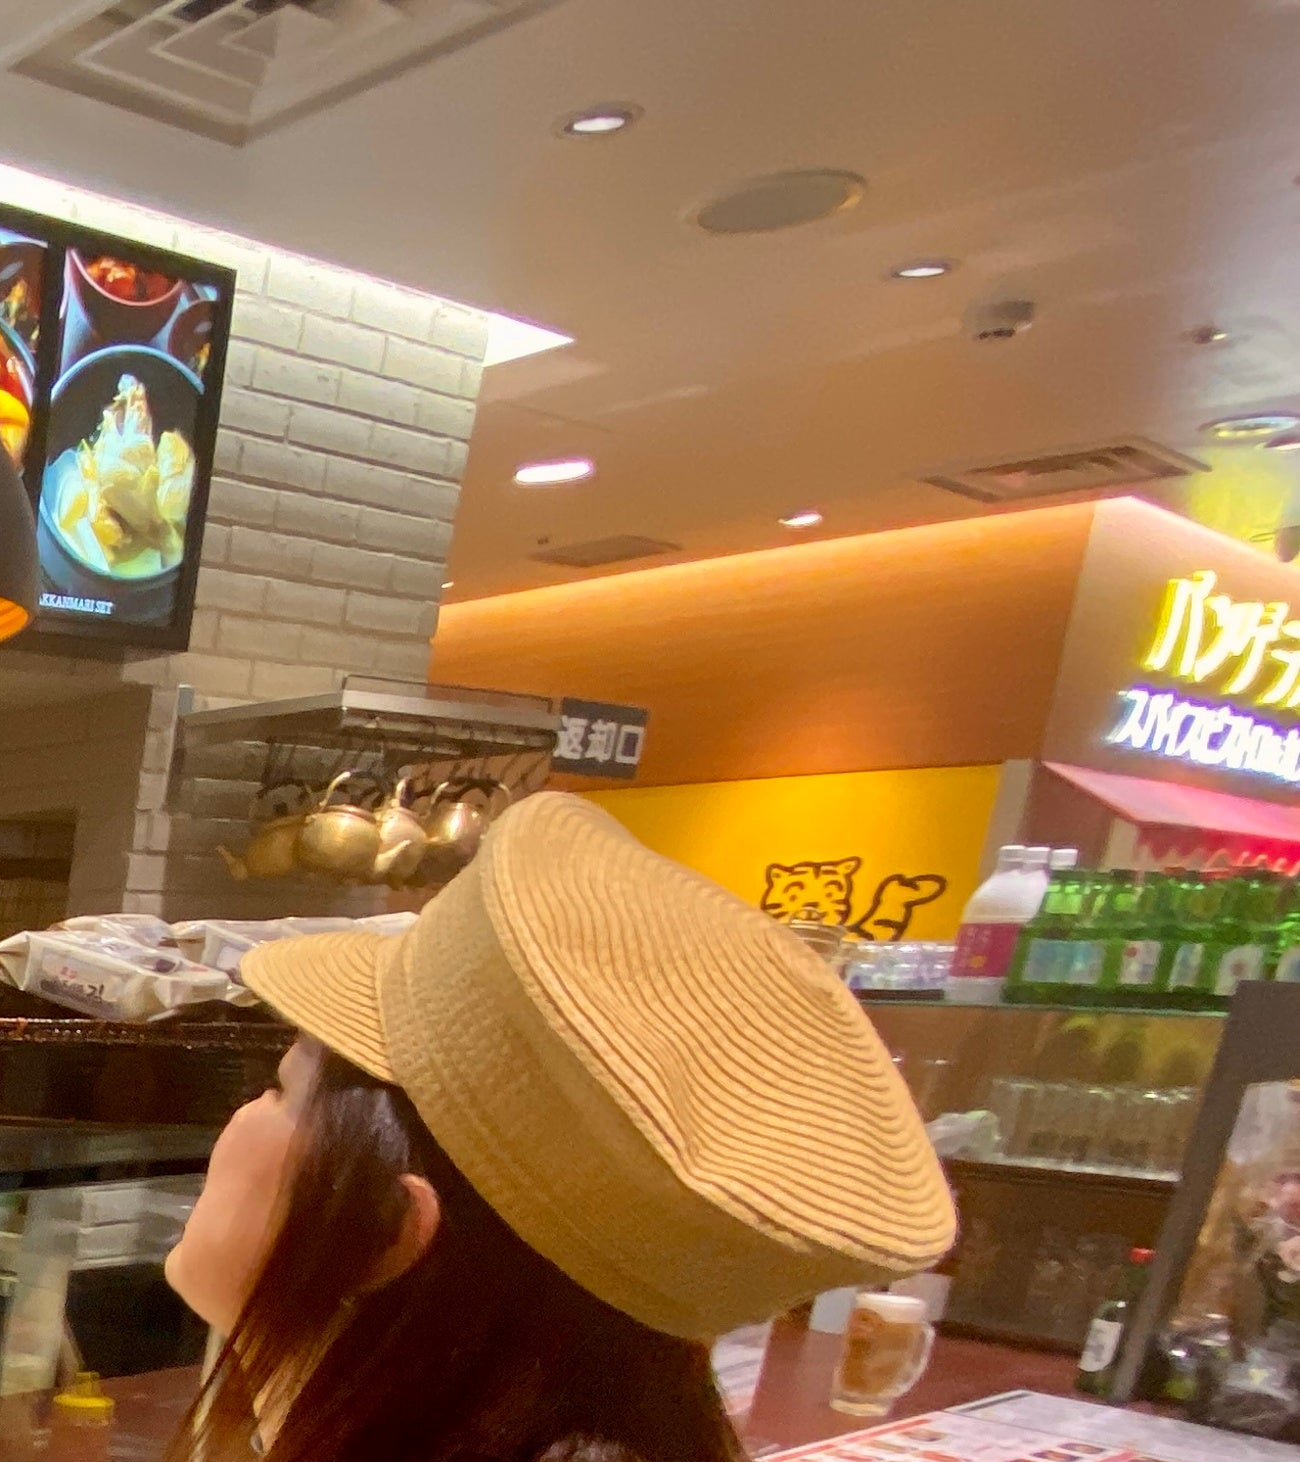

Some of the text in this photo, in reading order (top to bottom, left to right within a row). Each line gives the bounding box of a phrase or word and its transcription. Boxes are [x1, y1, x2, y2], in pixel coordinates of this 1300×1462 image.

[95, 600, 114, 615] SET
[553, 714, 645, 765] 返却口
